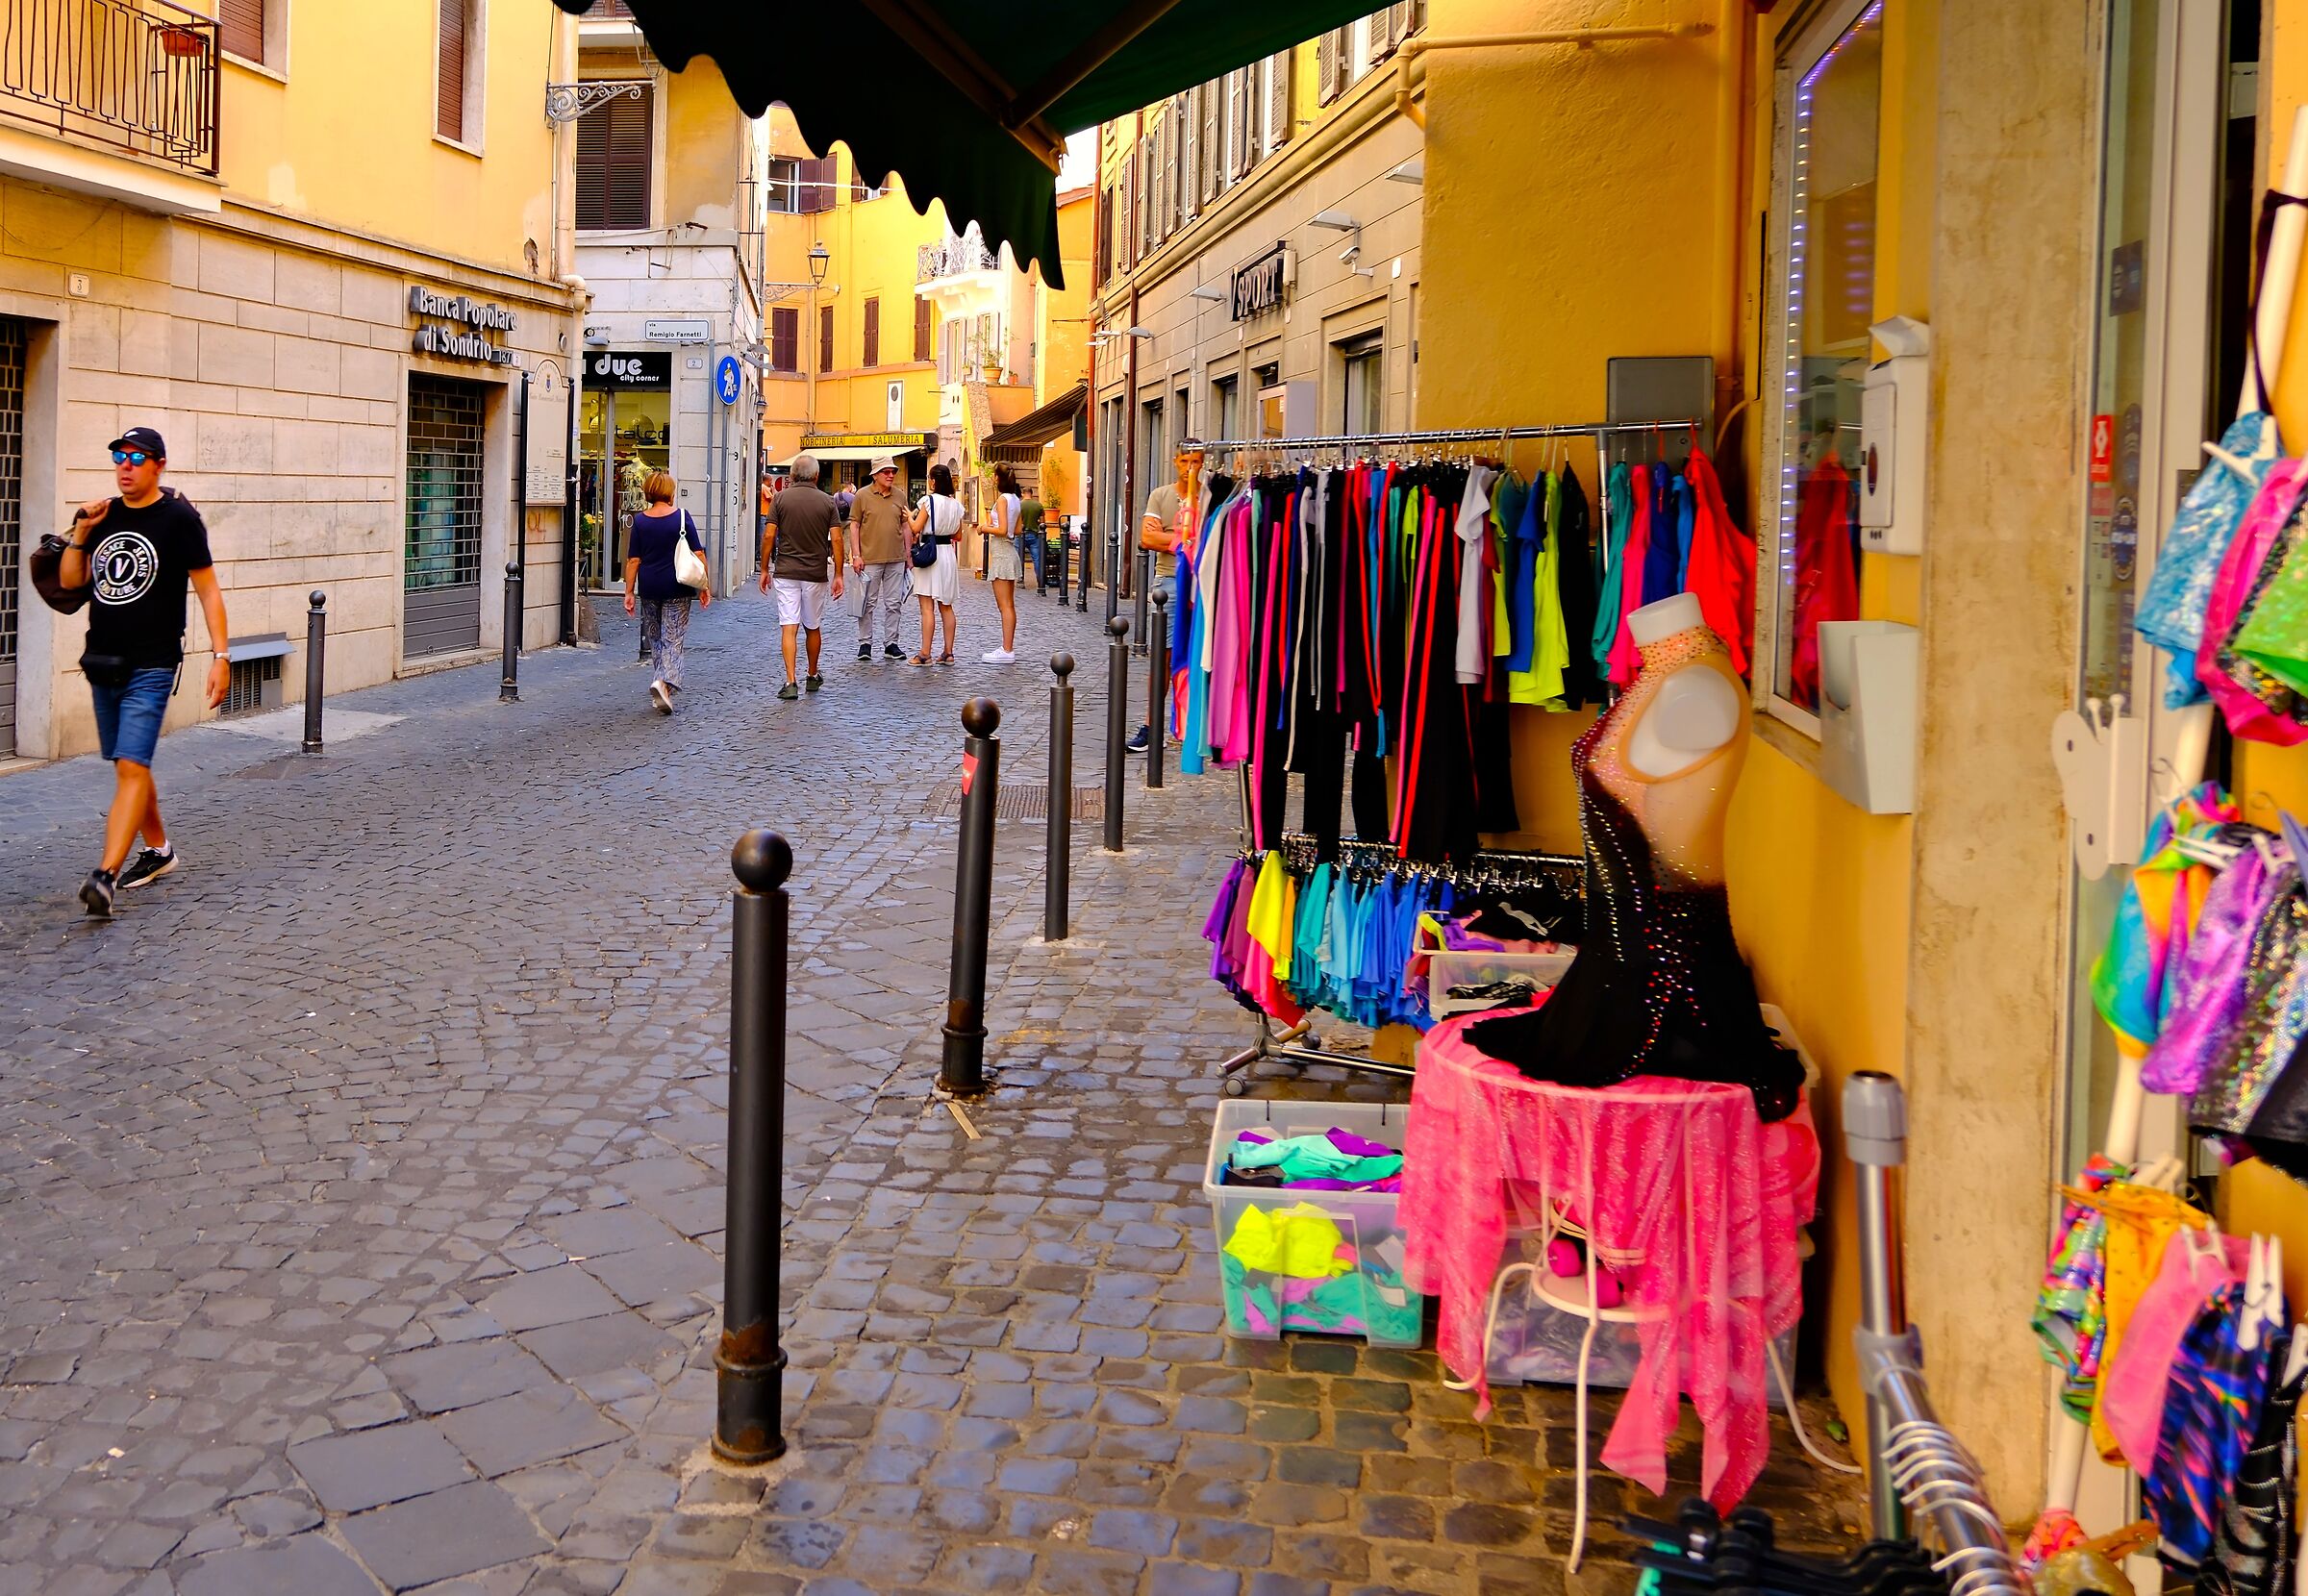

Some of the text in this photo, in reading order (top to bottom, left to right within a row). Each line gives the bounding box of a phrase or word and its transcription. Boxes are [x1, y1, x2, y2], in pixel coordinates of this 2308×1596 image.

[416, 287, 517, 331] Banca Popolare
[421, 325, 437, 352] di
[440, 327, 491, 361] Sondrio
[594, 354, 642, 375] due
[620, 374, 635, 383] city
[800, 436, 844, 447] NORCINERIA
[873, 436, 919, 445] SALUMERIA
[114, 557, 131, 579] V
[132, 546, 149, 578] JEANS
